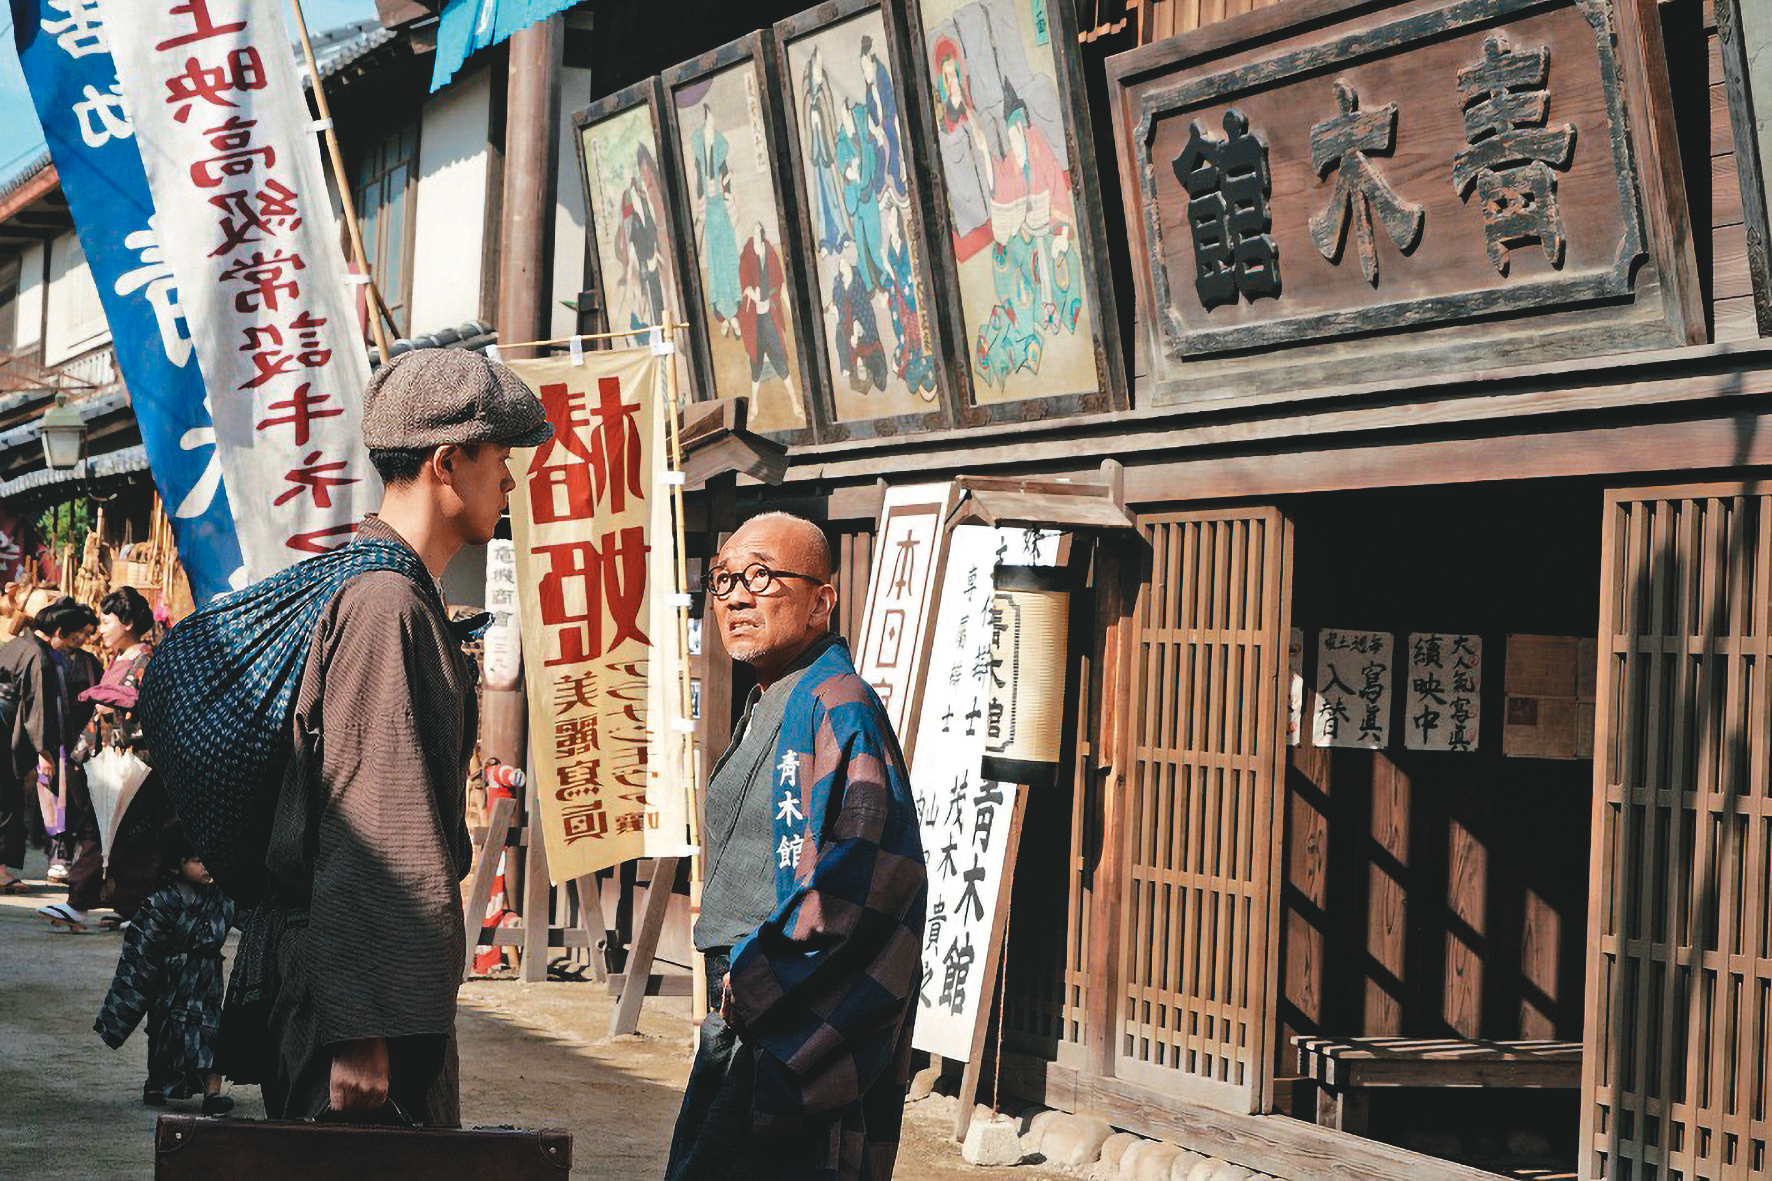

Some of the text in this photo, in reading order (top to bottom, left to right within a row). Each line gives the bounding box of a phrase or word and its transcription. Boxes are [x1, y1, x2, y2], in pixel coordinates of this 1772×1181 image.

[1172, 34, 1577, 312] 青木館
[776, 749, 804, 870] 青木館
[939, 780, 1003, 1016] 青木館
